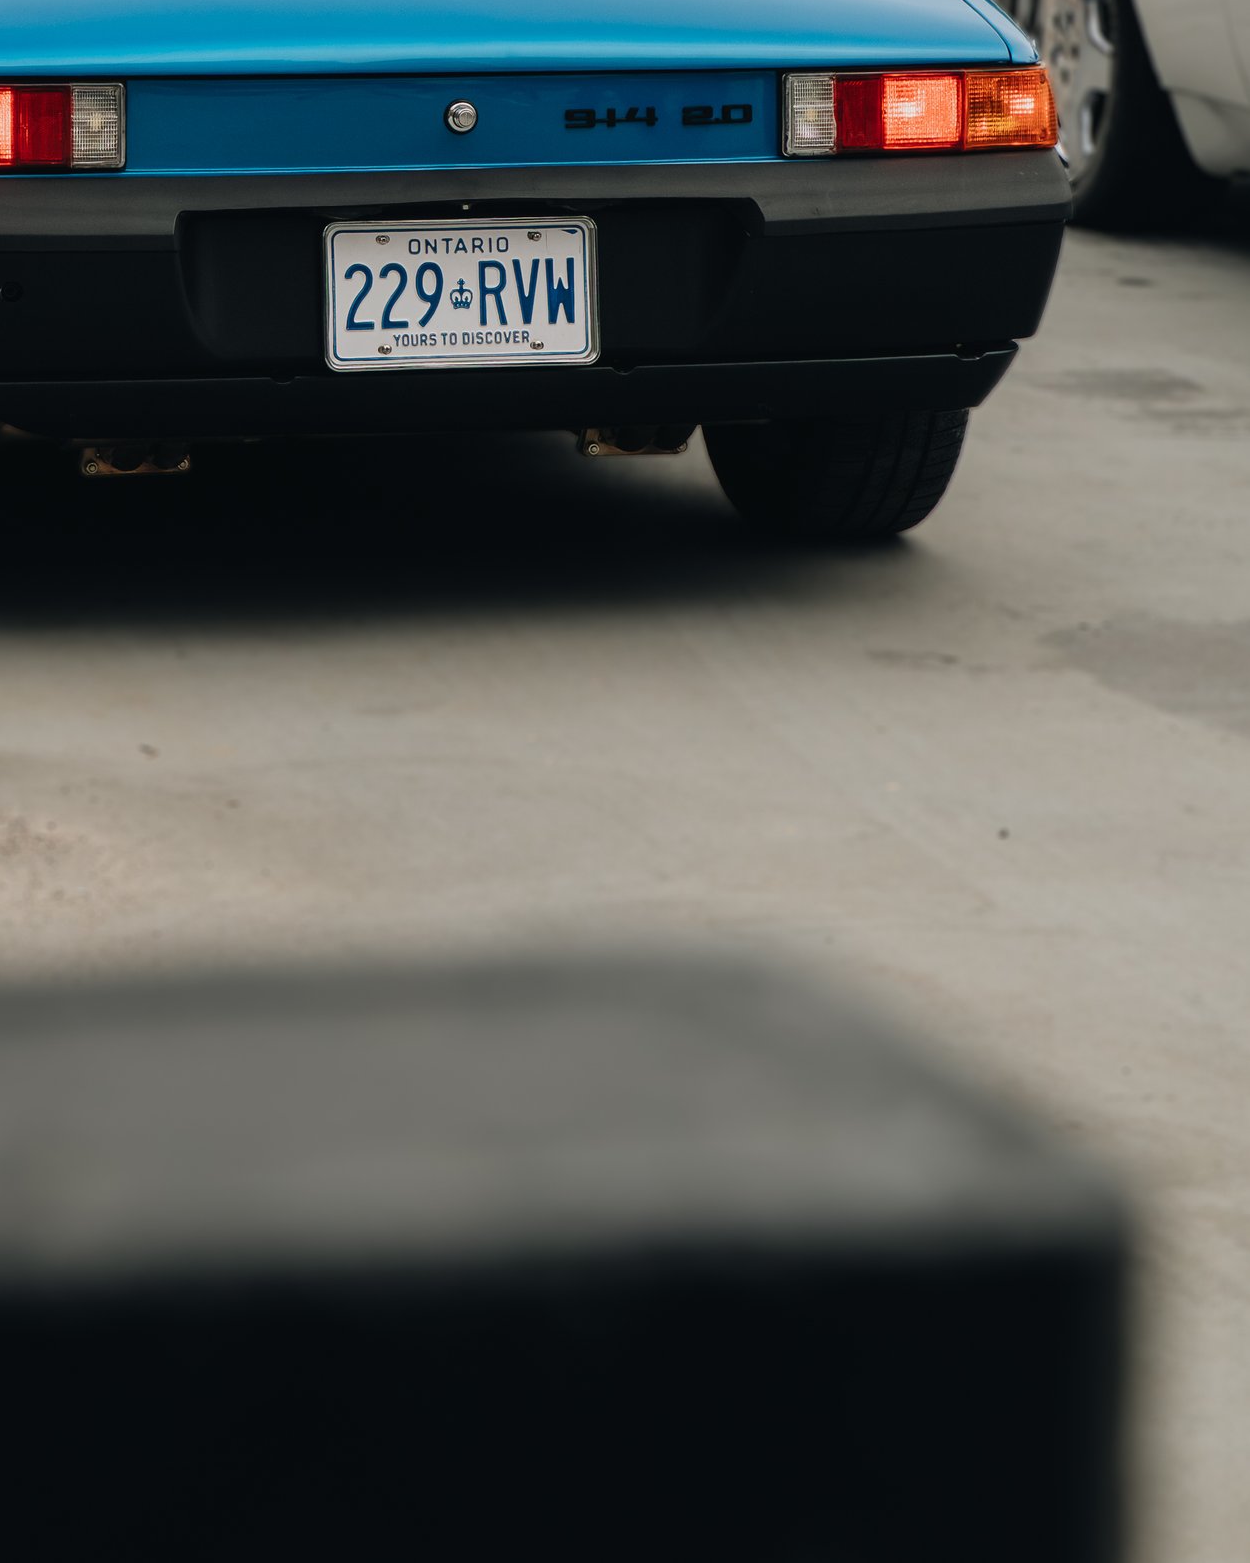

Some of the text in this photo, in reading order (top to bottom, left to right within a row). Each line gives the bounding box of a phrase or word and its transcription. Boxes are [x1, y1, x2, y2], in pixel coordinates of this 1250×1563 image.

[564, 104, 753, 129] 914 2.0
[408, 237, 509, 255] ONTARIO
[344, 257, 575, 331] 229 RVW
[393, 330, 530, 347] YOURS TO DISCOVER
